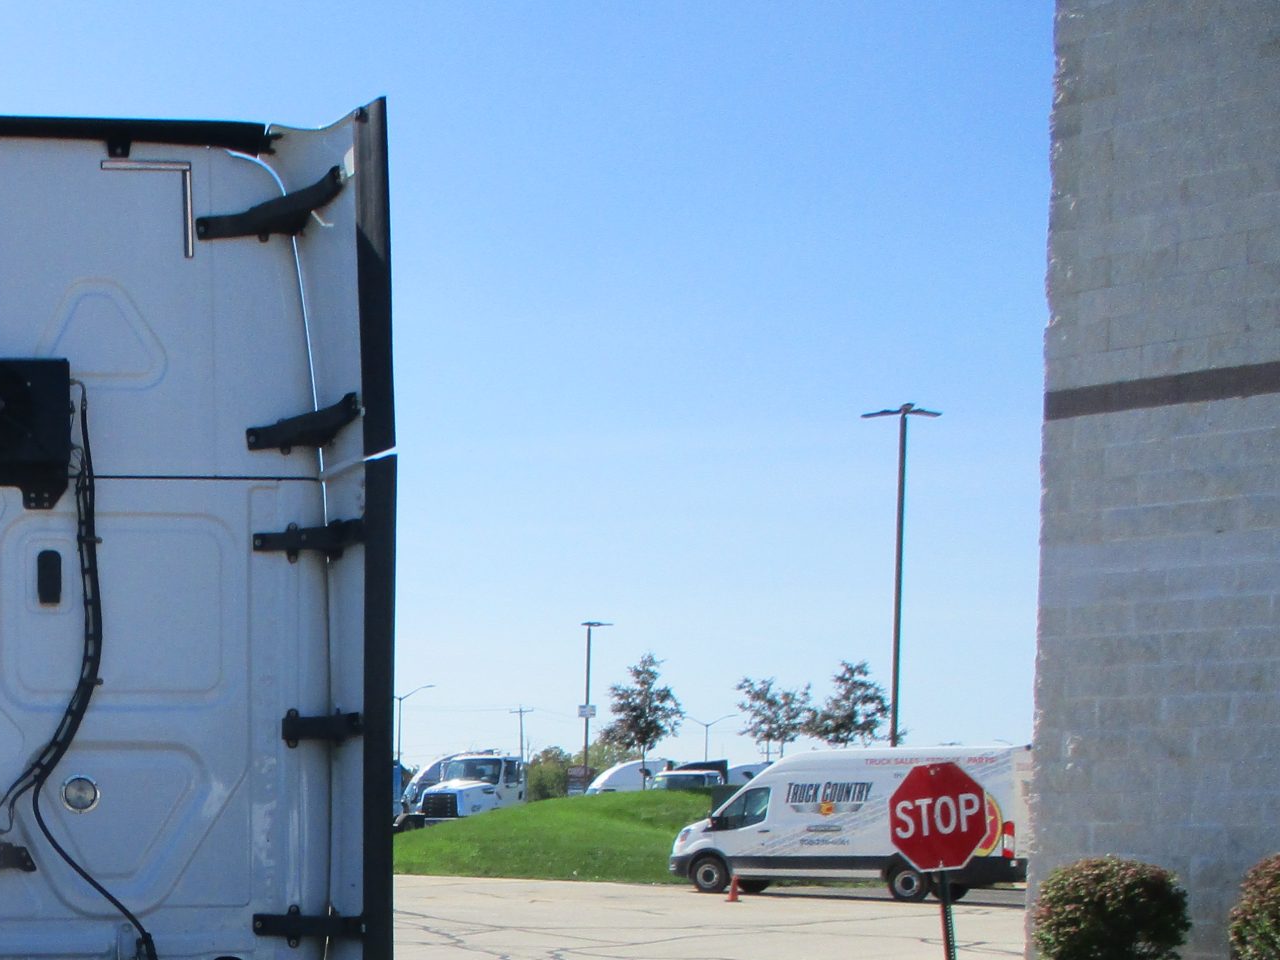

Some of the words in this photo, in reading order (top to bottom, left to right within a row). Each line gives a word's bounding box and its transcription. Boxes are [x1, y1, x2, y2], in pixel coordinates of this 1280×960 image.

[894, 757, 919, 765] SALES
[785, 782, 821, 803] TRUCK
[821, 781, 873, 803] COUNTRY
[895, 793, 980, 839] STOP
